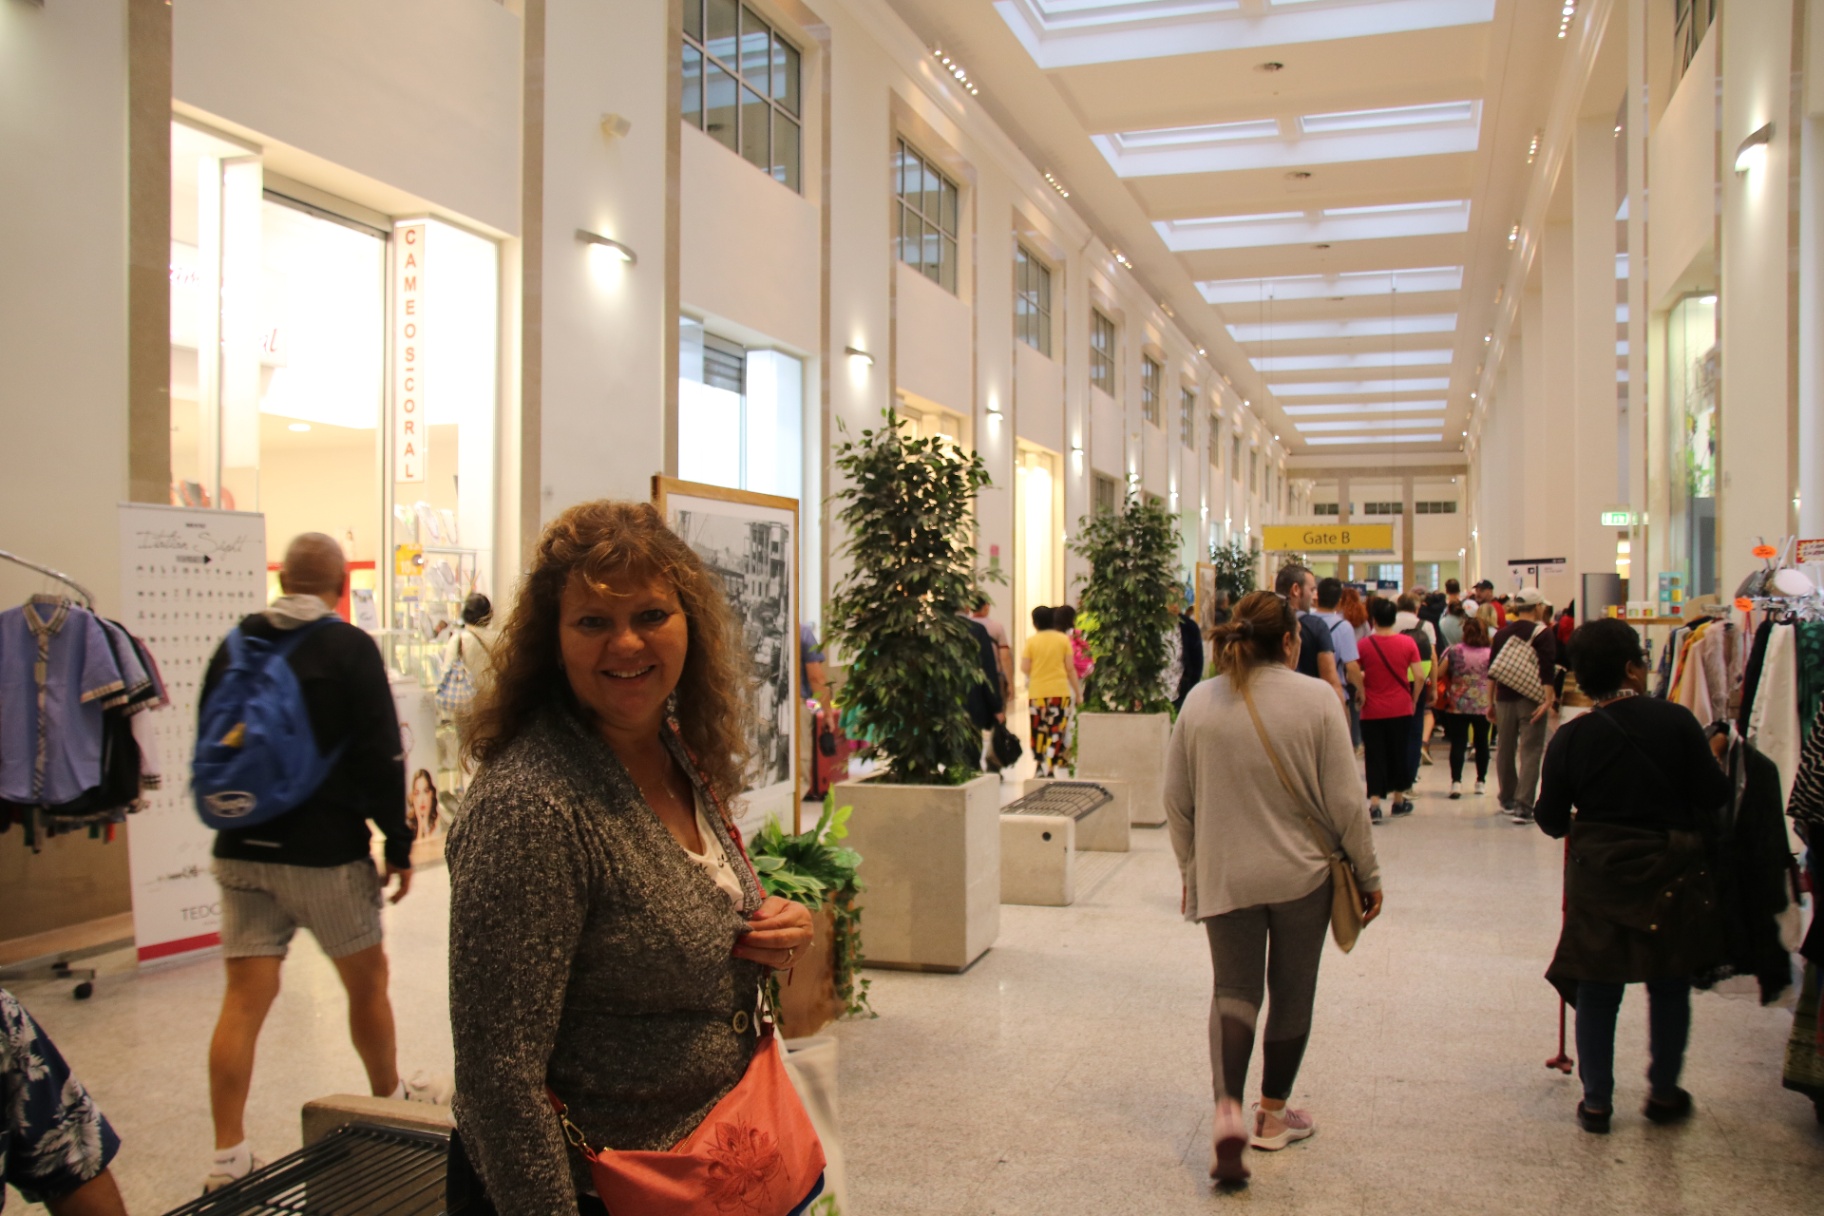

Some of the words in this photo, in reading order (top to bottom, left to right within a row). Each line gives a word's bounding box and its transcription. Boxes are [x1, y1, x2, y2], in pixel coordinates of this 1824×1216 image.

[403, 229, 416, 478] CAMEOS-CORAL
[1303, 531, 1337, 545] Gate
[1341, 531, 1350, 544] B
